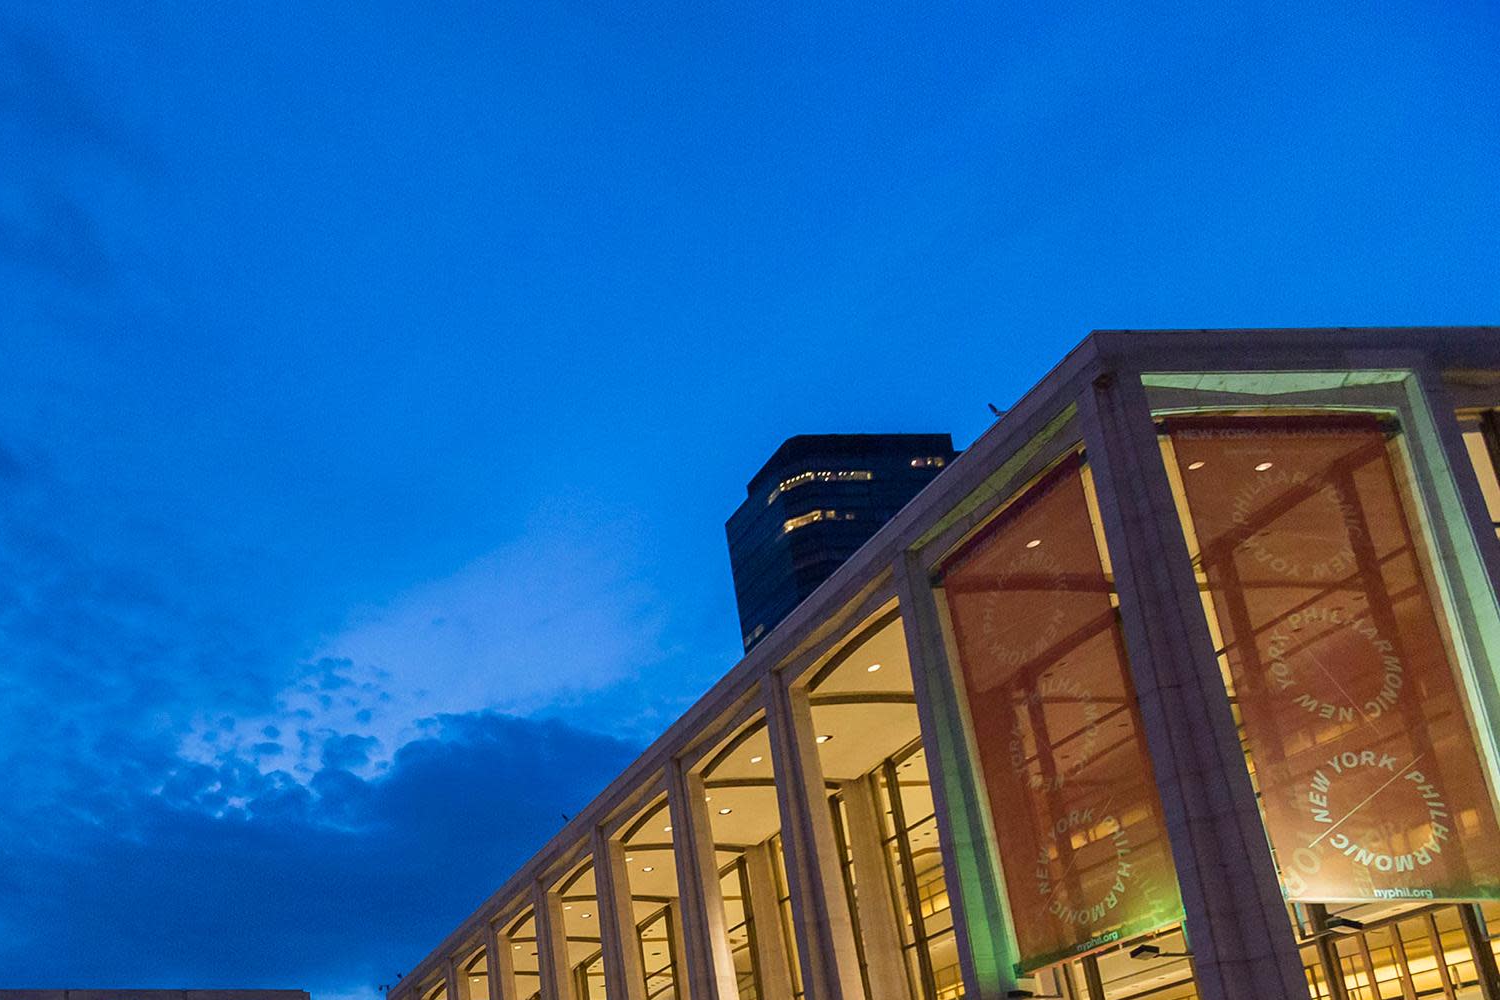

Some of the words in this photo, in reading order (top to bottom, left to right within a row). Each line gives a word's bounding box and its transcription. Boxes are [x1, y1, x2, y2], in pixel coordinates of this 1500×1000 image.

[1268, 629, 1297, 690] YORK
[1292, 694, 1353, 721] NEW
[1308, 768, 1332, 824] NEW
[1327, 750, 1397, 776] YORK
[1036, 847, 1051, 895] NEW
[1048, 809, 1094, 839] YORK
[1329, 770, 1449, 873] PHILHARMONIC
[1374, 888, 1433, 899] nyphil.org
